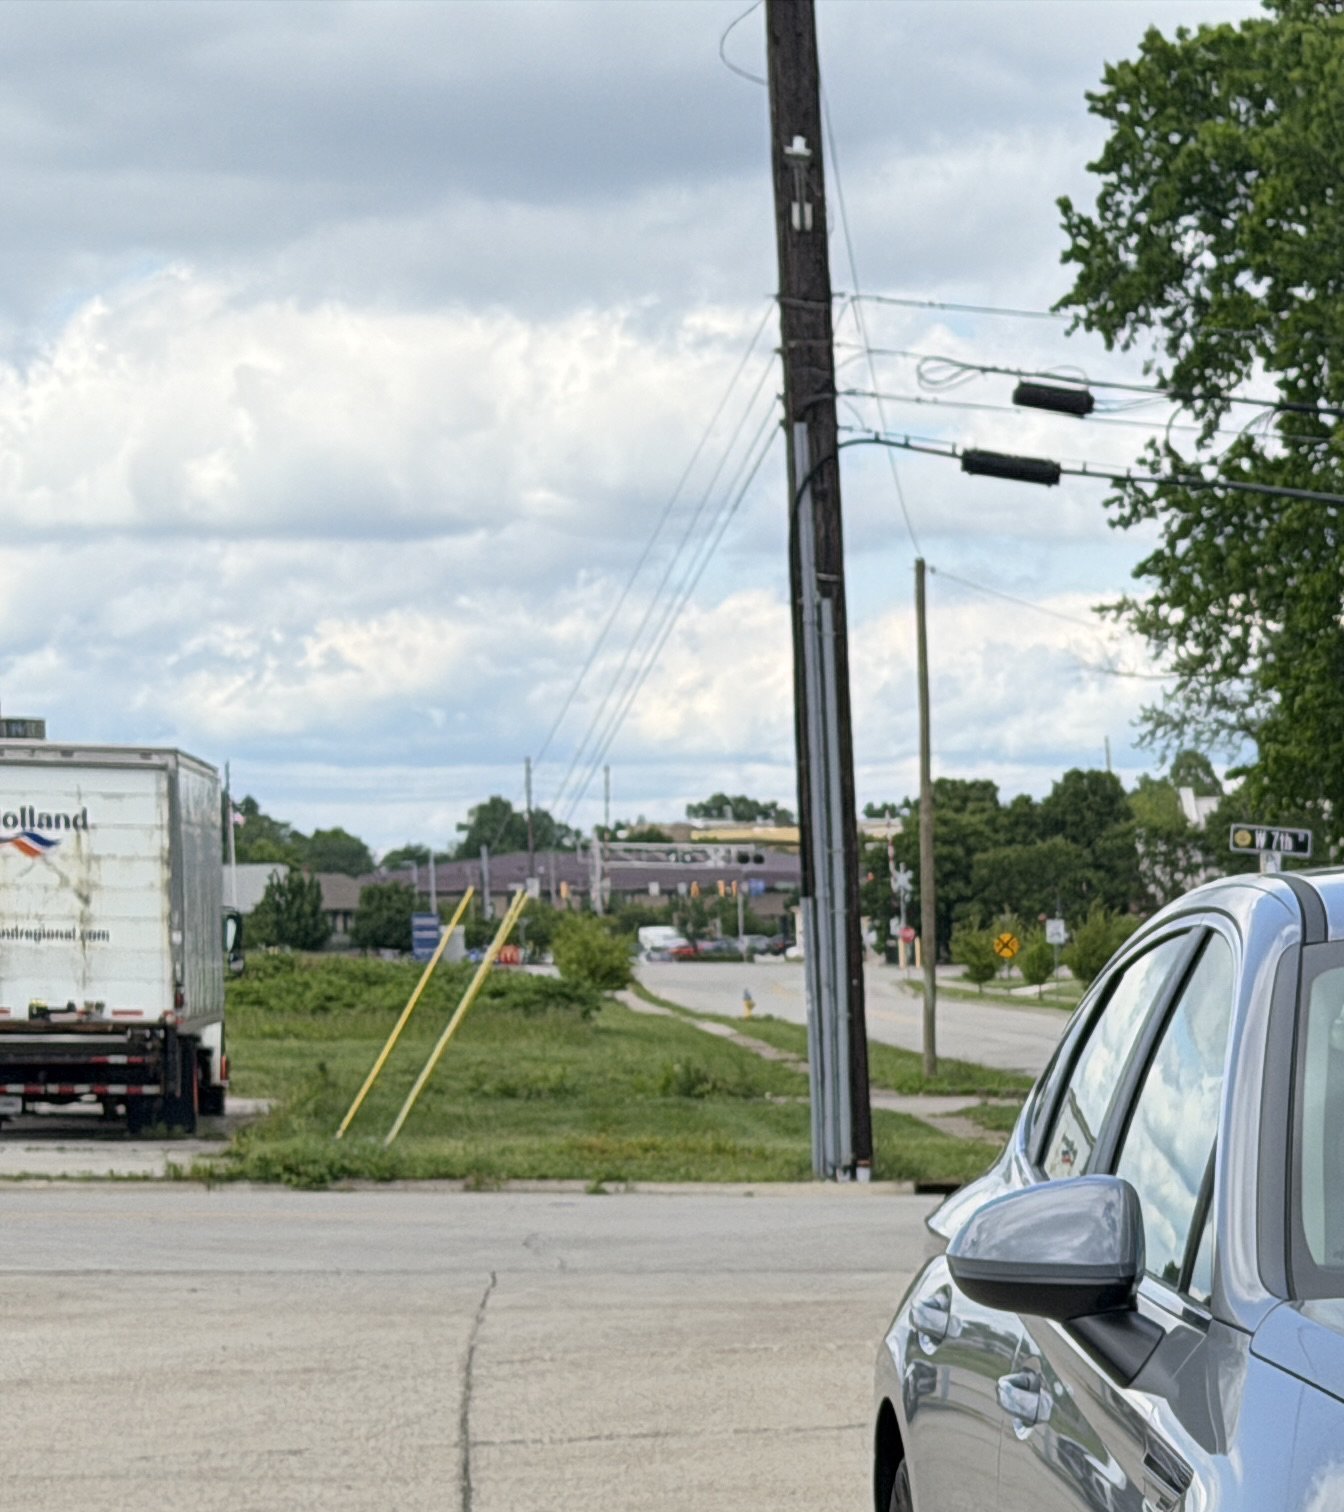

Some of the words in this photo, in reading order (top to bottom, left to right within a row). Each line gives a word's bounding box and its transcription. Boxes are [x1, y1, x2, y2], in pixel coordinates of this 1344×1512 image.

[2, 804, 88, 830] olland
[1255, 829, 1266, 849] W
[1271, 830, 1293, 851] 7th
[0, 924, 110, 943] ndregional.com
